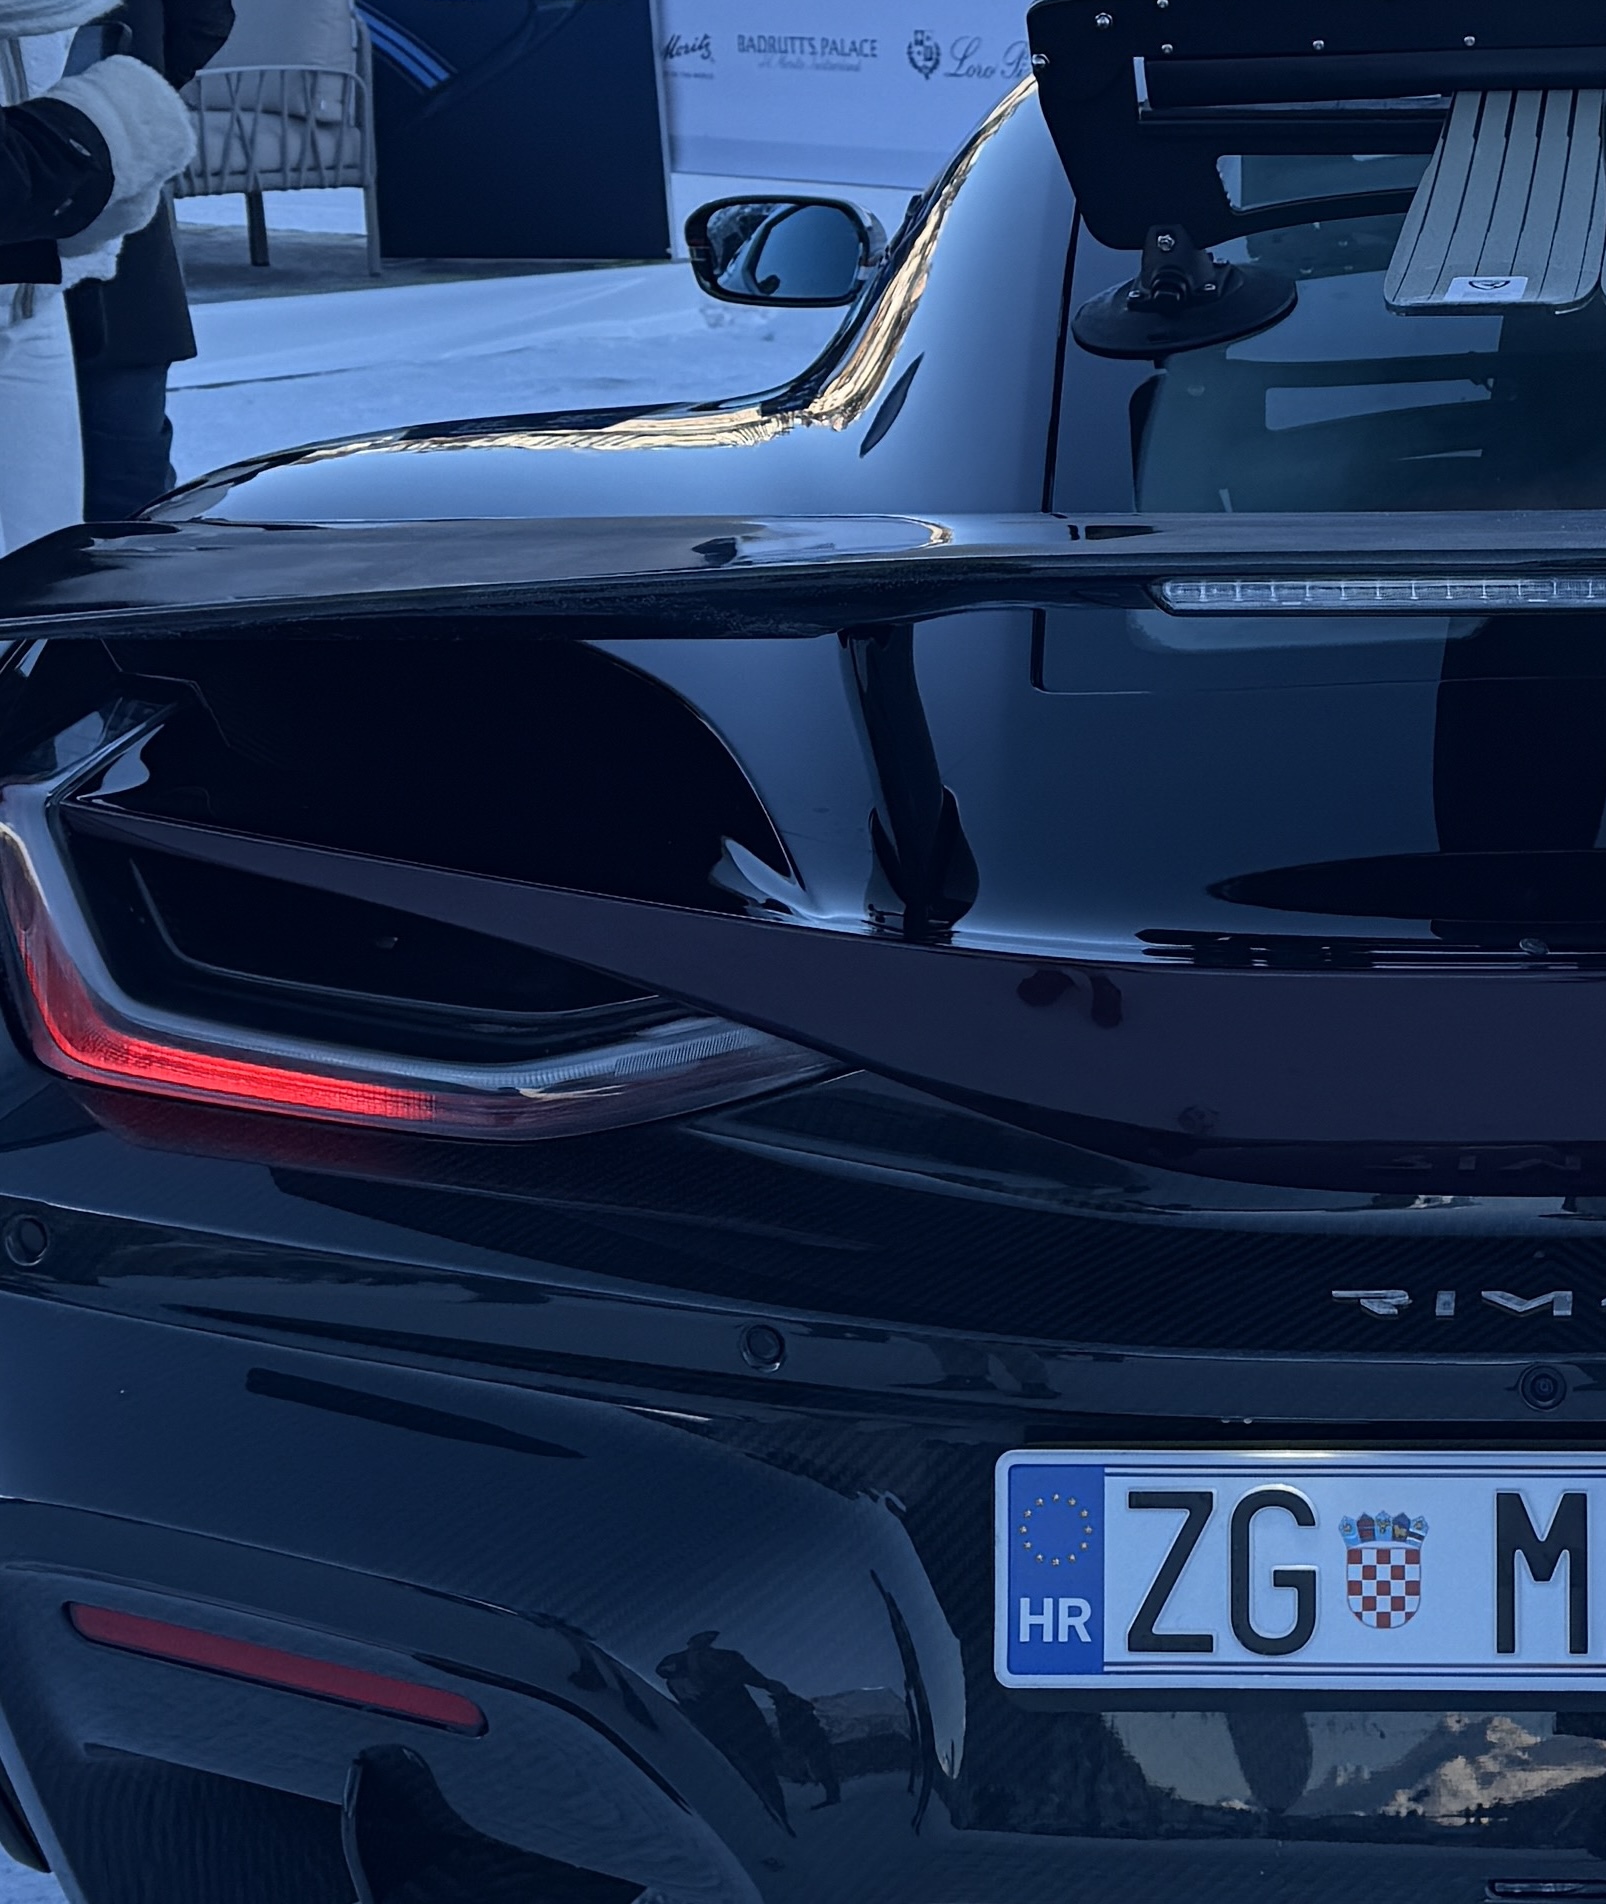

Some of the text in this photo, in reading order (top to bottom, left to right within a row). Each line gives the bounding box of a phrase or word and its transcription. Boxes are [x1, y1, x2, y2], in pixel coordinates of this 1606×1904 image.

[820, 36, 878, 58] PALACE
[943, 35, 998, 79] Loro
[1127, 1483, 1318, 1656] ZG
[1018, 1596, 1093, 1644] HR
